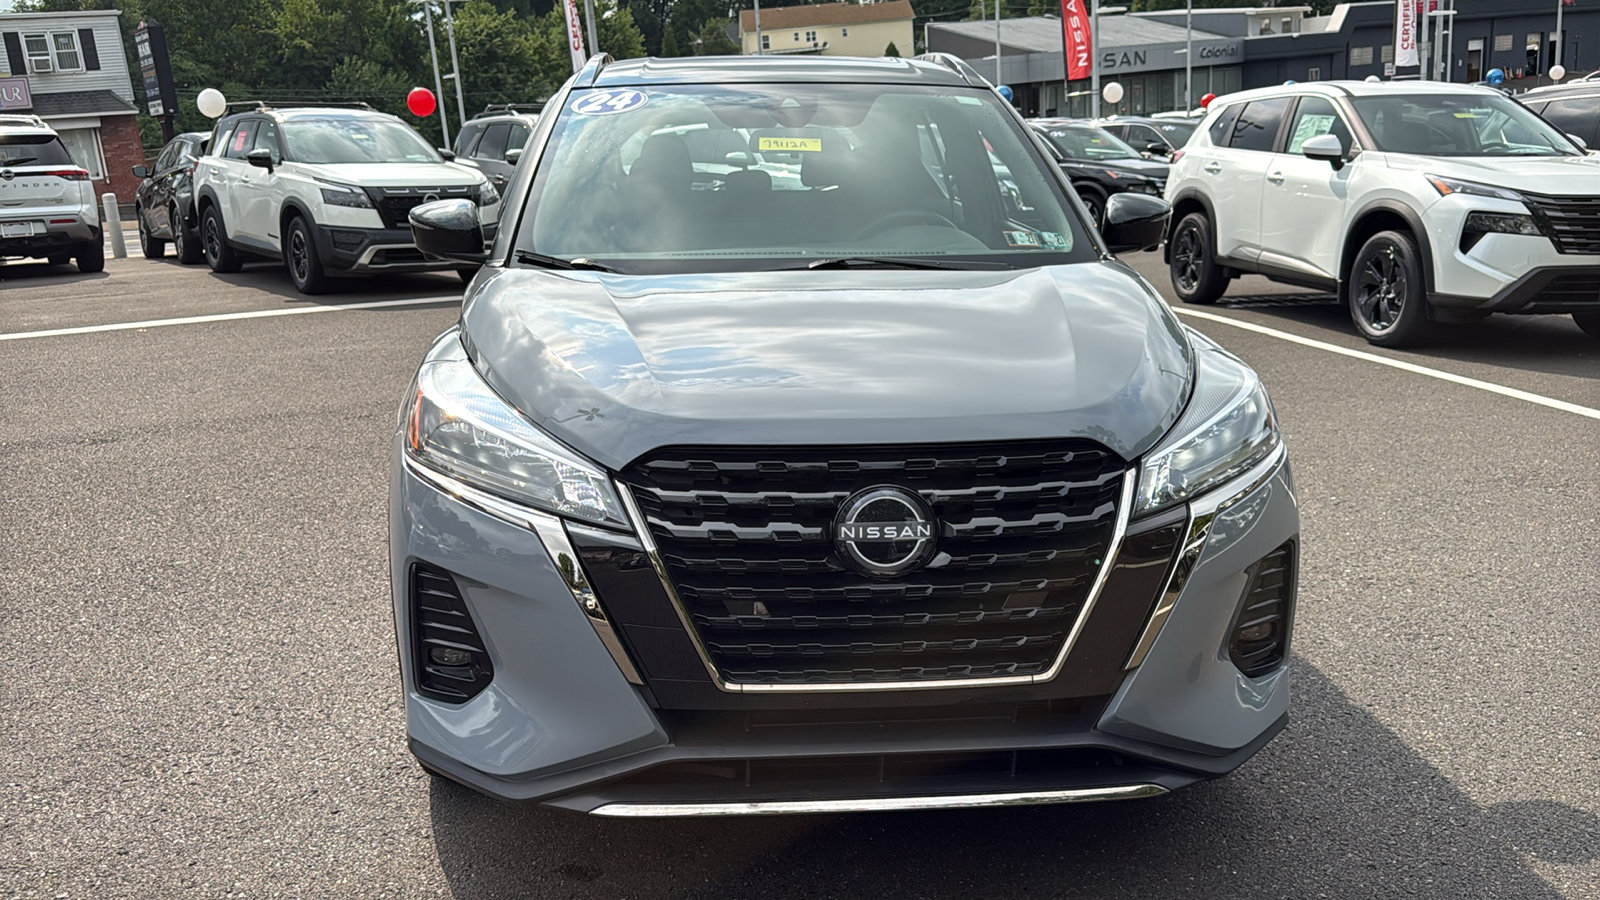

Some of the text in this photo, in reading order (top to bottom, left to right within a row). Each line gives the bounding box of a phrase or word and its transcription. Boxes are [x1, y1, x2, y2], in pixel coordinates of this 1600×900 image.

[1401, 0, 1411, 50] CERTIFIE
[1099, 50, 1147, 69] SAN
[1199, 44, 1239, 59] Colonial
[0, 86, 22, 102] UR
[579, 91, 637, 112] 24
[841, 524, 931, 539] NISSAN
